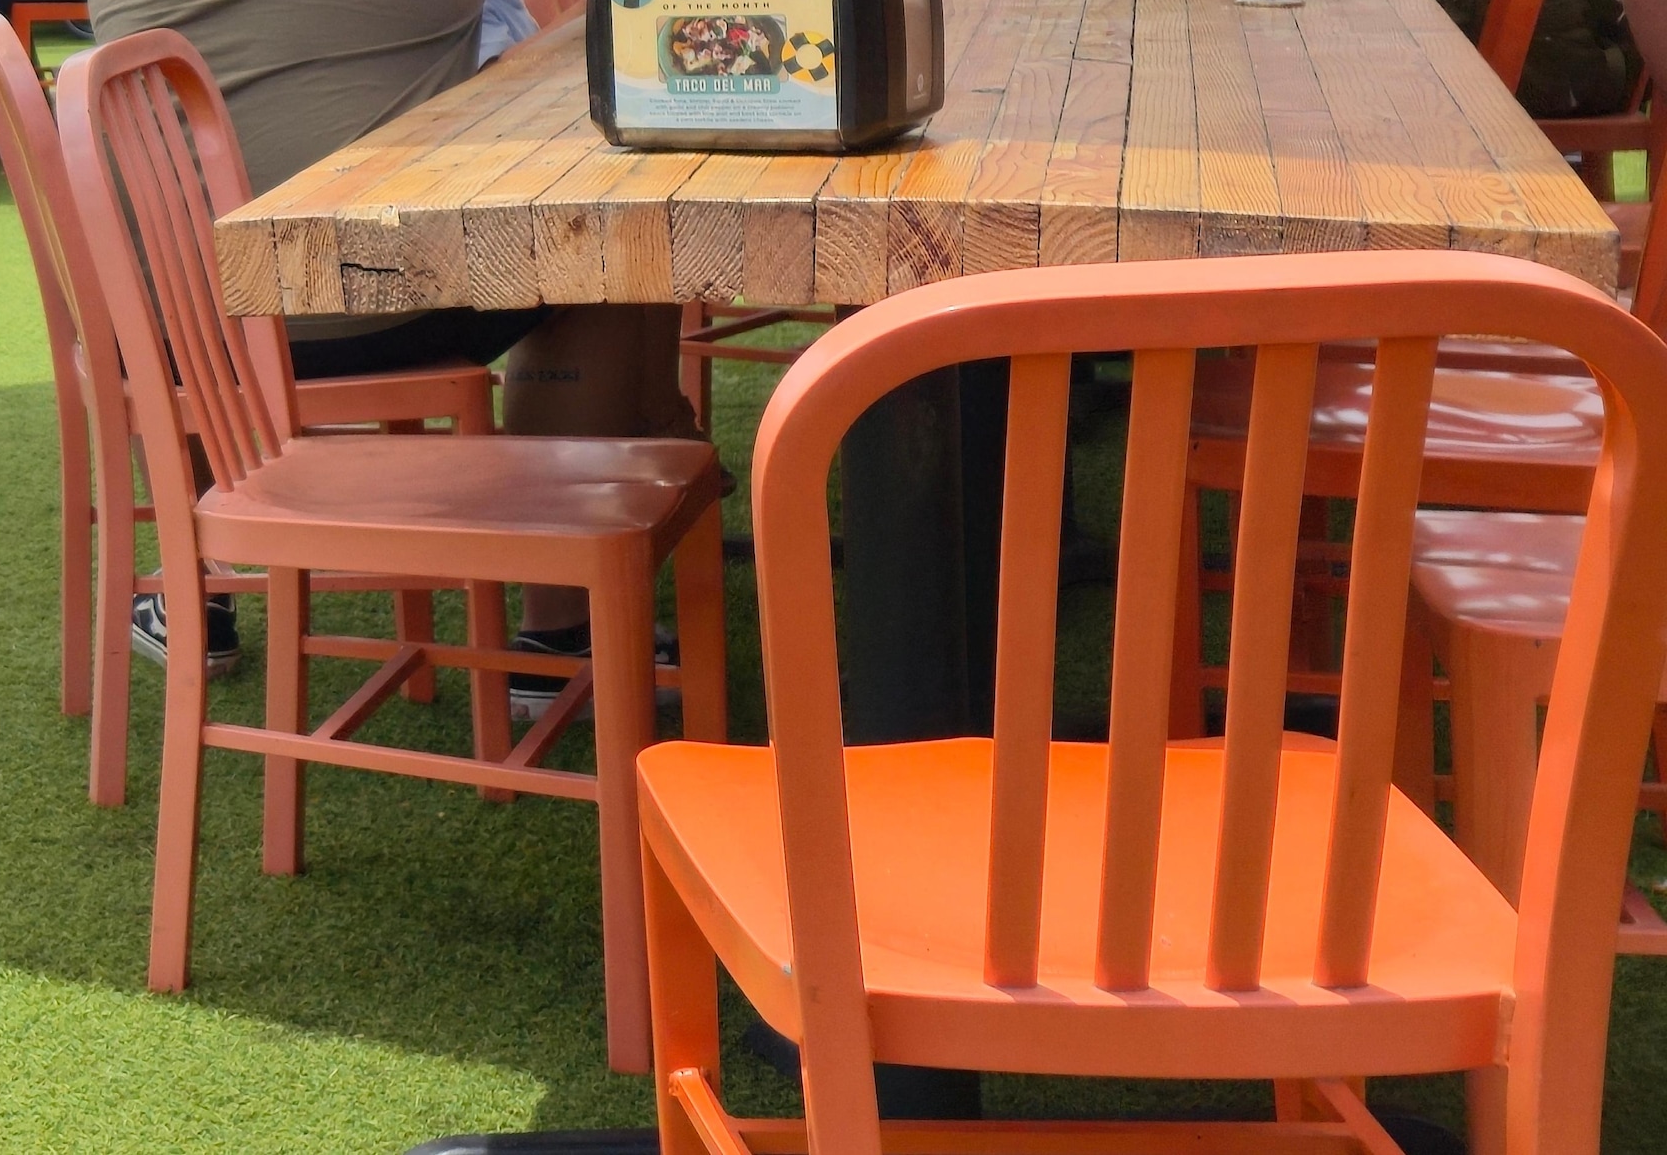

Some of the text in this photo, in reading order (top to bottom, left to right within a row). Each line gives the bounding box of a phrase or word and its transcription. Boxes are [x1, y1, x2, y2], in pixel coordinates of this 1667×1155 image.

[662, 3, 677, 11] OF
[675, 78, 771, 92] TACO DEL MAR
